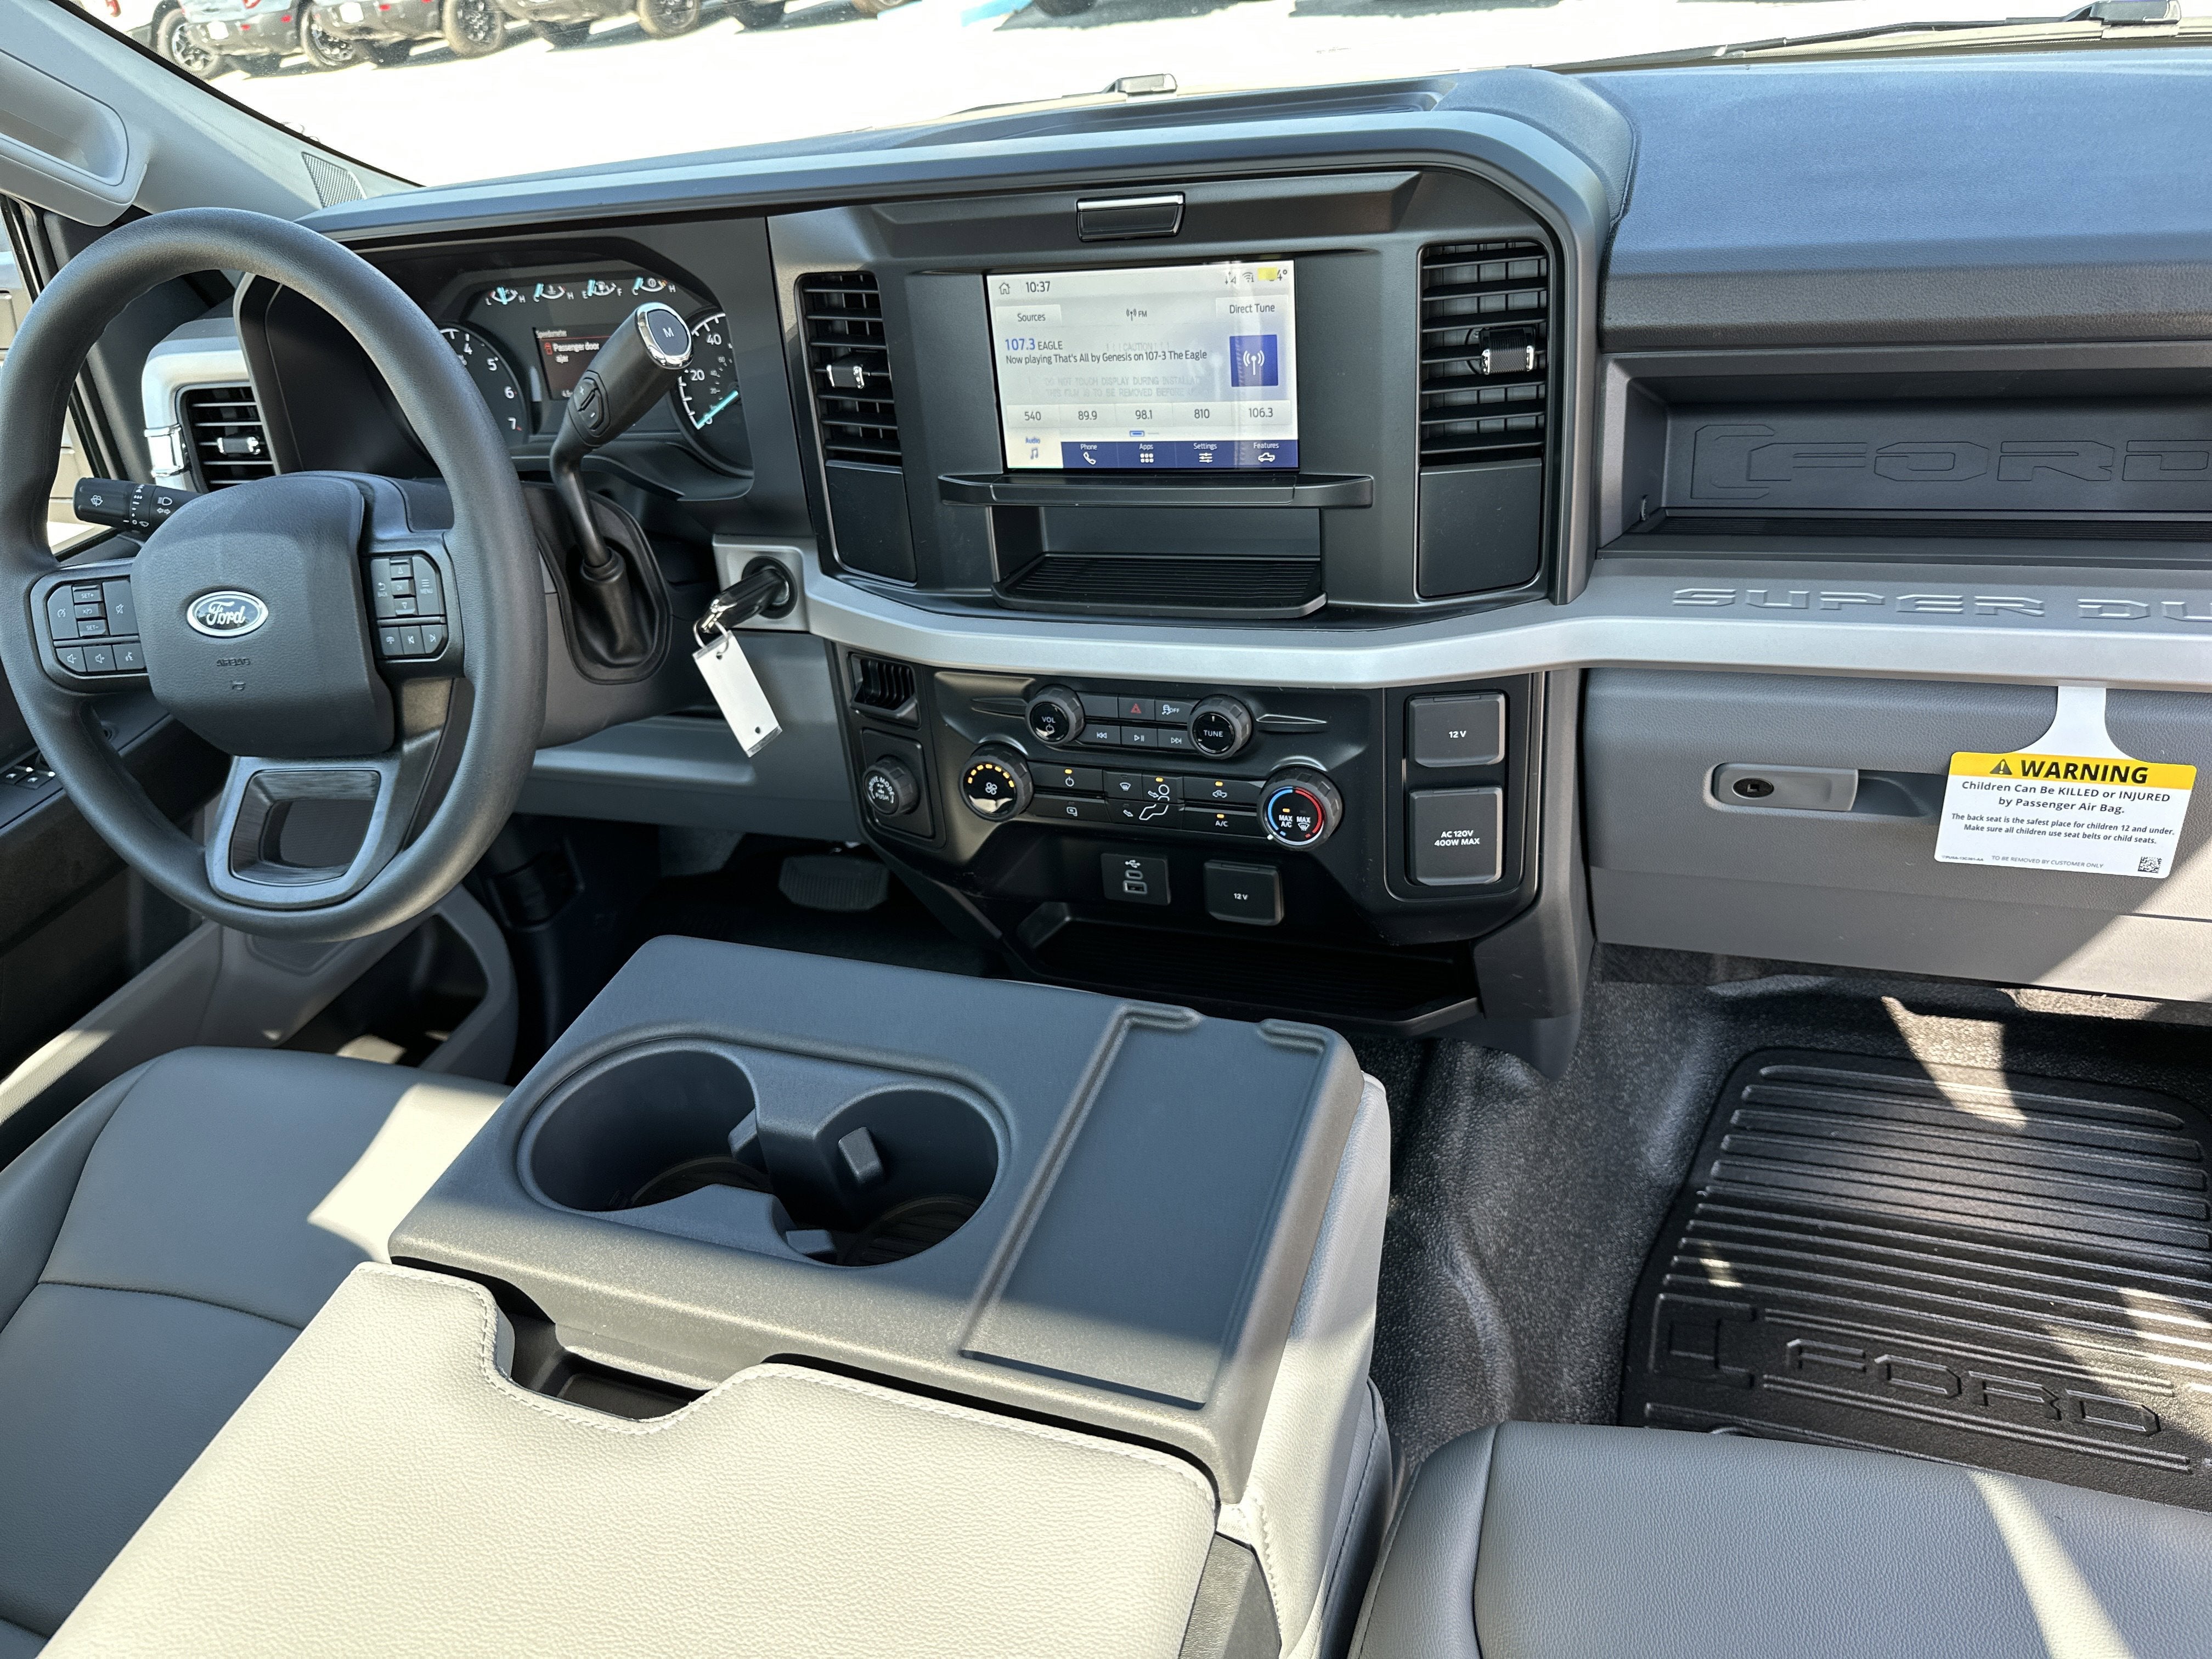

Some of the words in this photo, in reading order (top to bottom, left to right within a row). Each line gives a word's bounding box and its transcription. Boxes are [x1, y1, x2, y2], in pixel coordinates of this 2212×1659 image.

[617, 287, 623, 296] F
[668, 284, 676, 292] H
[1026, 281, 1051, 293] 10:37
[518, 295, 526, 303] H
[566, 291, 574, 300] H
[582, 290, 588, 299] E
[1229, 304, 1252, 314] Direct
[1254, 303, 1276, 313] Tune
[1017, 313, 1046, 322] Sources
[663, 327, 674, 338] M
[706, 334, 722, 345] 40
[1005, 338, 1036, 351] 107.3
[1038, 341, 1063, 350] EAGLE
[464, 343, 473, 355] 4
[1006, 356, 1023, 364] Now
[1025, 354, 1052, 365] playing
[1053, 353, 1077, 363] That's
[1079, 353, 1089, 362] All
[1091, 353, 1101, 364] by
[1102, 352, 1132, 362] Genesis
[1145, 351, 1166, 360] 107-3
[1168, 351, 1183, 359] The
[1185, 350, 1207, 360] Eagle
[487, 358, 497, 371] 5
[690, 369, 705, 381] 20
[504, 386, 515, 399] 6
[1024, 411, 1041, 421] 540
[1078, 410, 1097, 420] 89.9
[1135, 410, 1153, 420] 98.1
[1194, 409, 1210, 419] 810
[1249, 408, 1273, 418] 106.3
[507, 417, 516, 430] 7
[1193, 442, 1217, 450] Settings
[1746, 439, 2212, 482] FORD
[1672, 588, 2045, 617] SUPER
[206, 601, 246, 625] Ford
[1448, 730, 1459, 738] 12
[2021, 760, 2149, 785] WARNING
[1962, 781, 2011, 792] Children
[2015, 785, 2036, 793] Can
[2040, 786, 2055, 794] Be
[2058, 787, 2099, 798] KILLED
[2119, 791, 2170, 802] INJURED
[1998, 797, 2013, 807] by
[2016, 798, 2076, 811] Passenger
[2078, 803, 2097, 811] Air
[2100, 804, 2125, 815] Bag.
[2027, 818, 2049, 826] safest
[2051, 820, 2071, 828] place
[2086, 822, 2118, 831] children
[2149, 827, 2175, 835] under.
[1453, 830, 1474, 838] 120V
[2016, 827, 2046, 836] children
[2113, 834, 2132, 842] child
[1434, 838, 1459, 847] 400W
[1461, 837, 1480, 845] MAX
[1786, 1338, 2162, 1435] FORD
